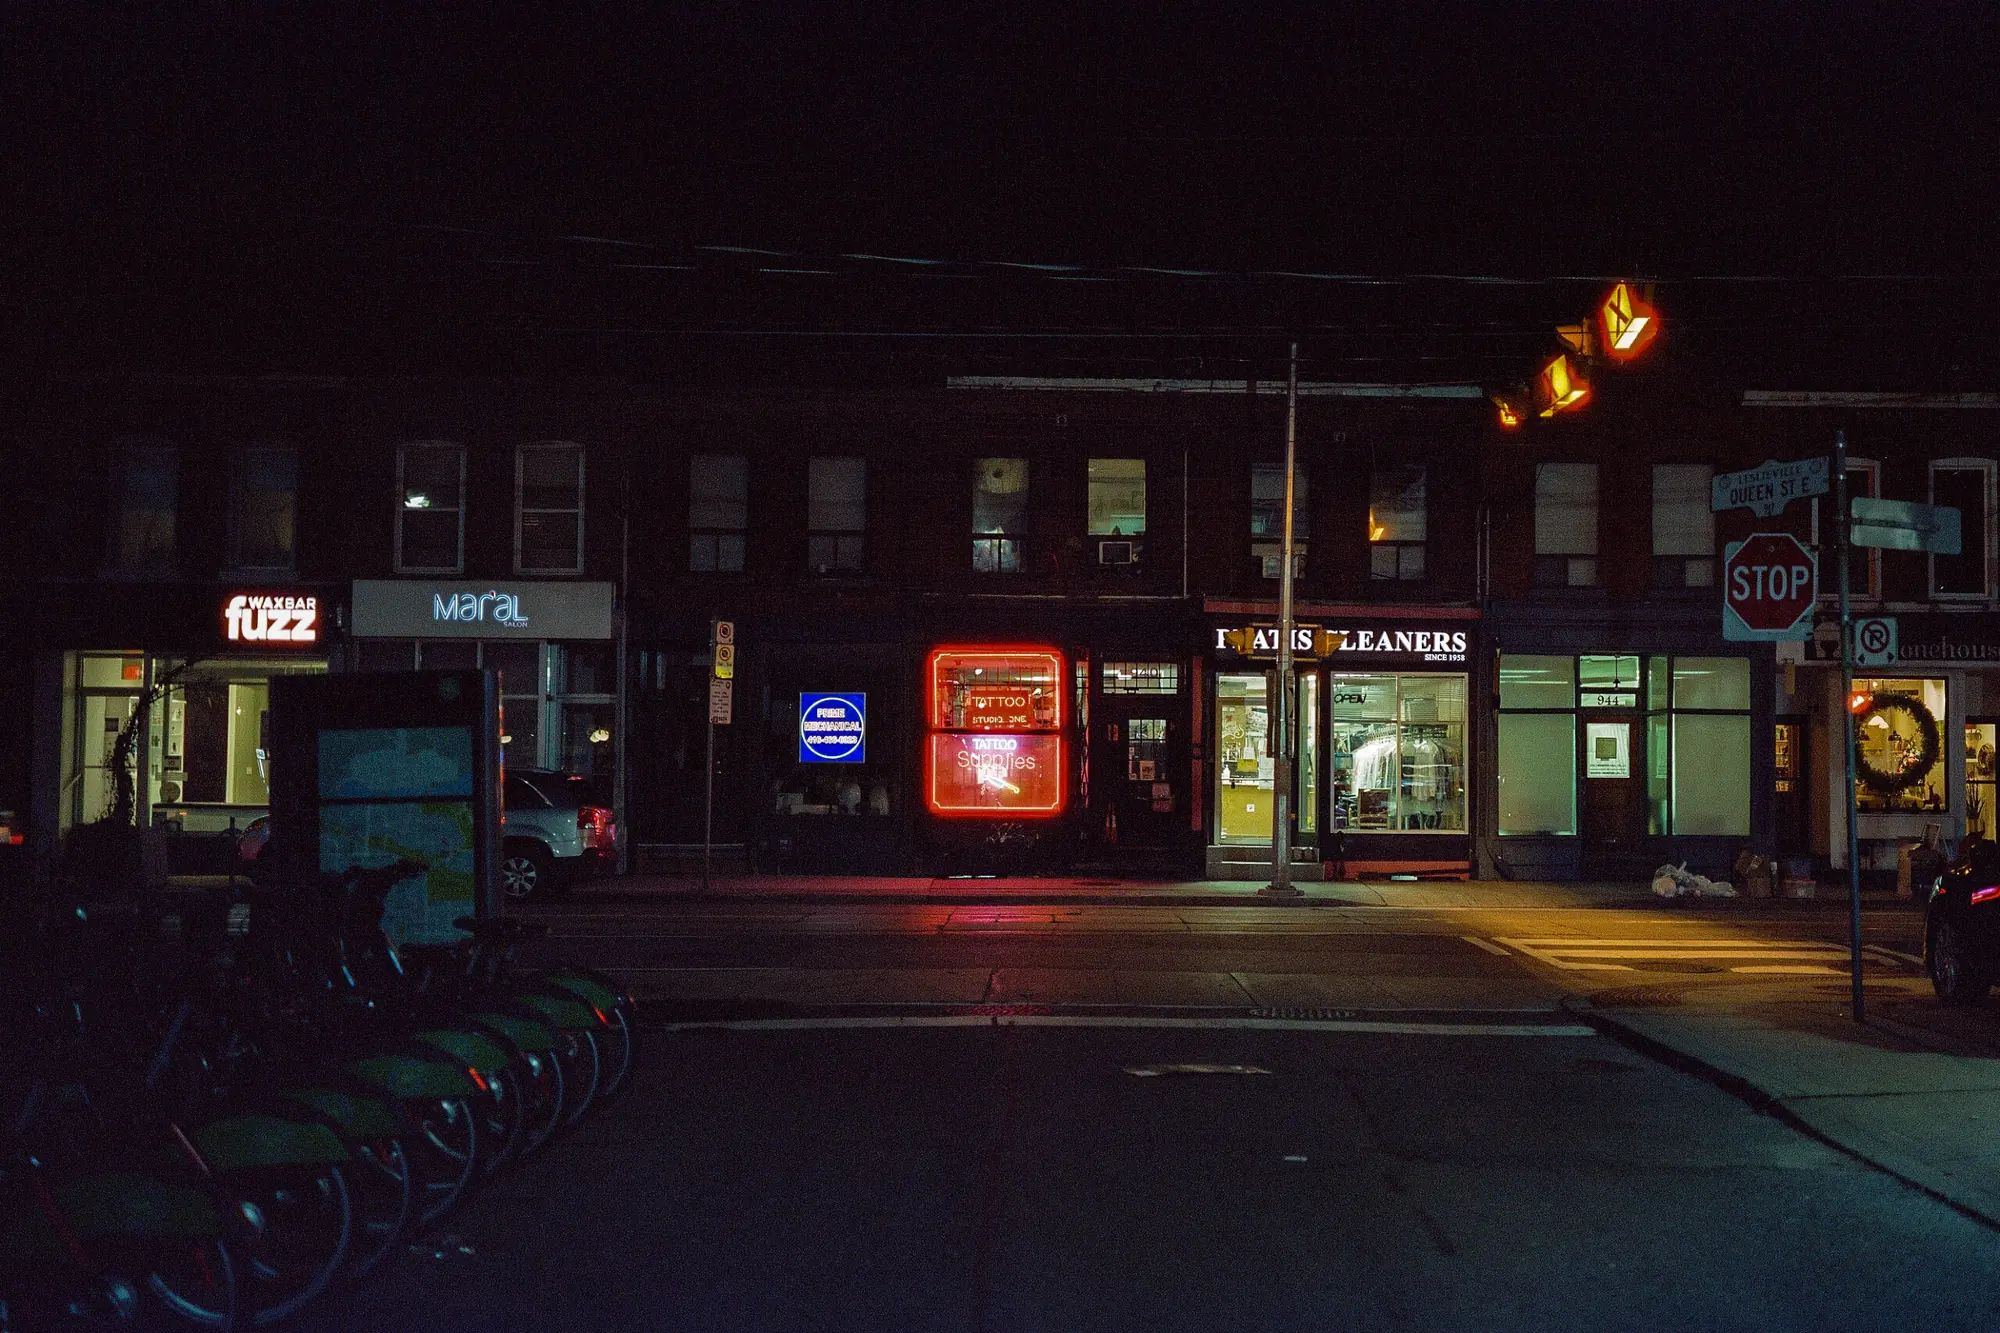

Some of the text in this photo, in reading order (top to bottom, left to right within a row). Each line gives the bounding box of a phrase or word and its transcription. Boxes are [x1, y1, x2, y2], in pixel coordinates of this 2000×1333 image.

[1730, 476, 1810, 505] QUEEN ST E
[1731, 564, 1810, 601] STOP
[225, 595, 317, 641] fuzz
[503, 621, 529, 629] SALON
[1326, 629, 1467, 653] LEANERS
[1424, 653, 1466, 662] SINCE 1958
[972, 696, 1026, 707] TATTOO
[1334, 693, 1367, 704] OPEN
[1597, 695, 1619, 705] 944
[817, 708, 845, 718] PRIME
[803, 721, 862, 731] MECHANICAL
[972, 739, 1018, 750] TATTOO
